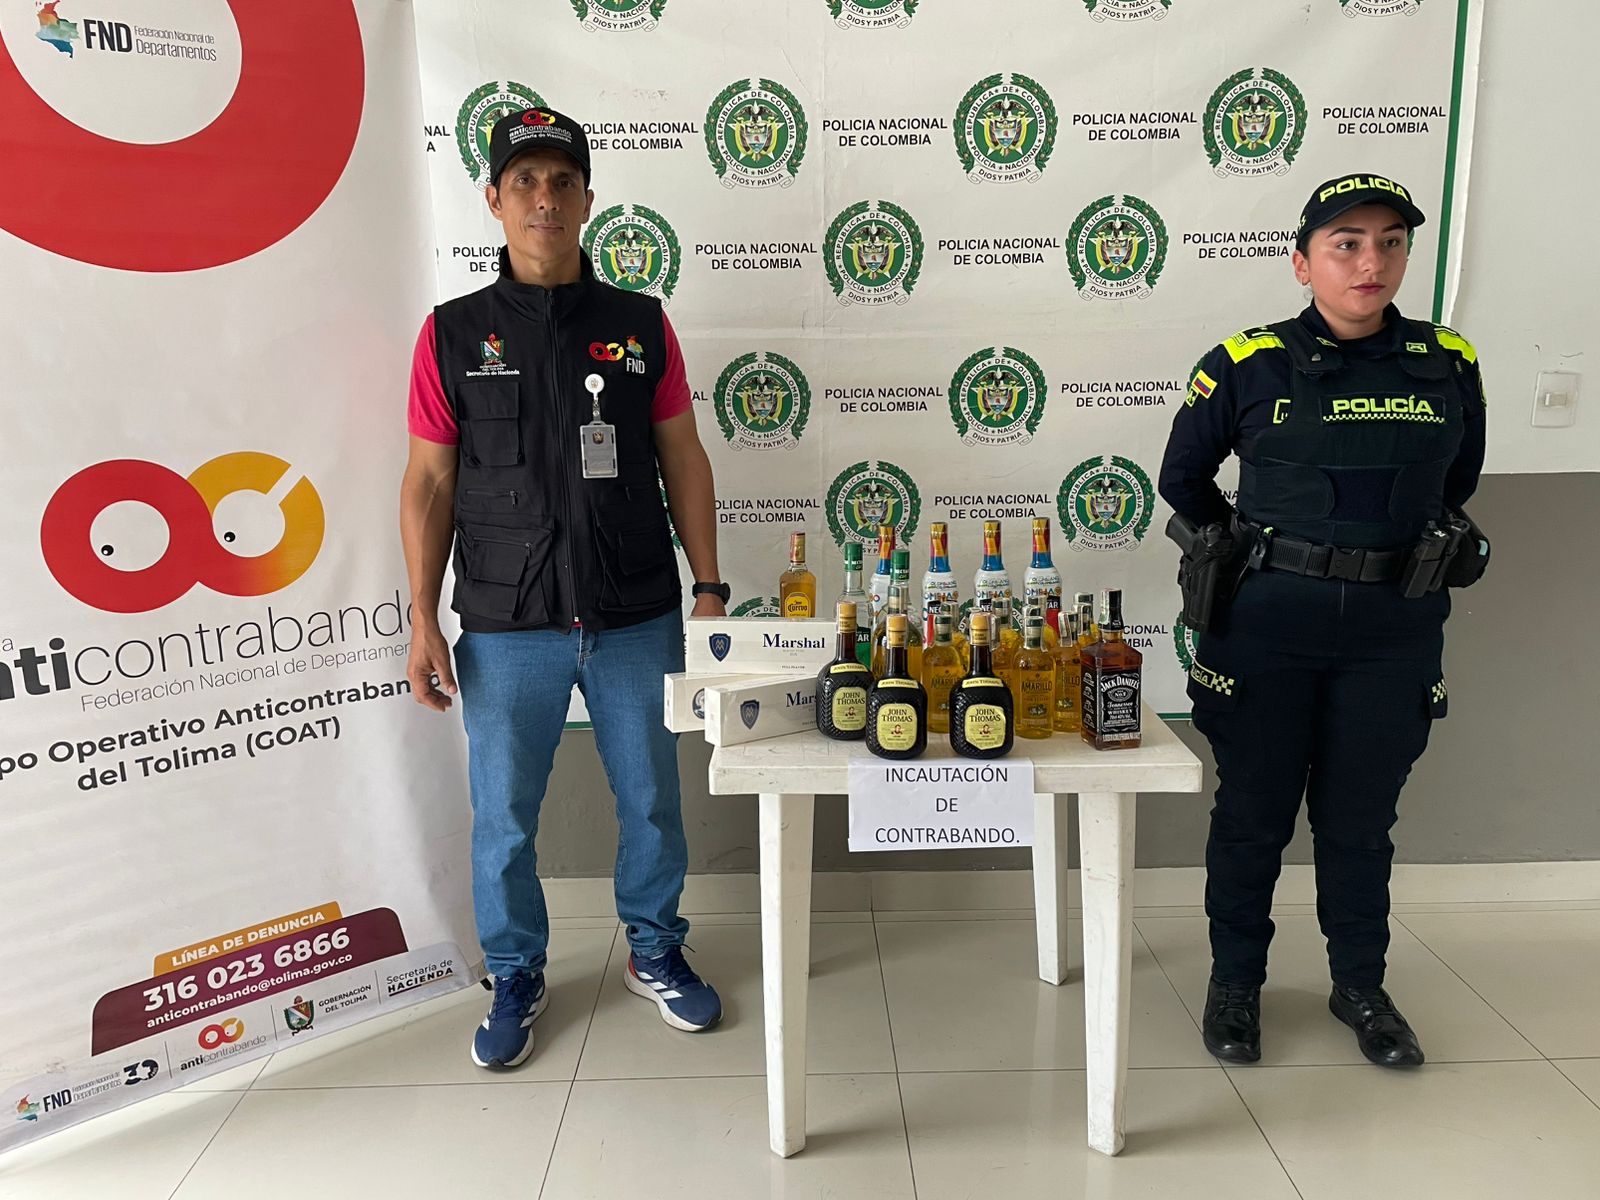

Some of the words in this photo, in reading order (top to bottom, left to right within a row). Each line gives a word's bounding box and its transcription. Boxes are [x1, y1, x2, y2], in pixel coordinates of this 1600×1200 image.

[592, 16, 612, 29] DIOS
[619, 16, 647, 30] PATRIA
[84, 19, 132, 53] FND
[134, 25, 173, 40] Federación
[174, 31, 204, 44] Nacional
[204, 35, 215, 44] de
[136, 39, 217, 62] Departamentos
[1215, 84, 1245, 130] REPUBLICA
[1270, 85, 1293, 129] COLOMBIA
[1323, 107, 1375, 119] POLICIA
[1378, 106, 1446, 118] NACIONAL
[718, 96, 743, 141] REPUBLICA
[770, 96, 795, 141] COLOMBIA
[822, 119, 876, 131] POLICIA
[879, 117, 948, 130] NACIONAL
[1072, 113, 1126, 125] POLICIA
[1130, 112, 1197, 124] NACIONAL
[582, 123, 625, 135] OLICIA
[629, 122, 698, 134] NACIONAL
[1088, 130, 1106, 141] DE
[1110, 128, 1180, 140] COLOMBIA
[1338, 123, 1355, 134] DE
[1359, 122, 1429, 134] COLOMBIA
[591, 139, 607, 150] DE
[611, 138, 683, 150] COLOMBIA
[839, 136, 856, 147] DE
[860, 134, 931, 146] COLOMBIA
[1218, 139, 1244, 164] POLICIA
[1252, 138, 1290, 164] NACIONAL
[723, 150, 748, 175] POLICIA
[757, 150, 793, 176] NACIONAL
[1225, 162, 1244, 174] DIOS
[1251, 161, 1280, 174] PATRIA
[731, 173, 750, 186] DIOS
[757, 172, 784, 187] PATRIA
[1320, 177, 1409, 203] POLICIA
[1183, 232, 1236, 244] POLICIA
[1239, 230, 1297, 243] NACIONA
[695, 244, 747, 255] POLICIA
[750, 242, 817, 254] NACIONAL
[938, 239, 990, 251] POLICIA
[993, 238, 1060, 250] NACIONAL
[453, 246, 500, 258] POLICIA
[953, 255, 970, 265] DE
[974, 253, 1044, 264] COLOMBIA
[1199, 248, 1217, 259] DE
[1220, 247, 1289, 258] COLOMBIA
[470, 262, 487, 272] DE
[711, 259, 728, 270] DE
[732, 258, 802, 270] COLOMBIA
[626, 357, 646, 374] FND
[726, 367, 750, 408] REPUBLICA
[775, 367, 799, 408] COLOMBIA
[825, 388, 874, 399] POLICIA
[878, 386, 943, 398] NACIONAL
[1061, 382, 1112, 394] POLICIA
[1115, 381, 1181, 393] NACIONAL
[840, 402, 857, 413] DE
[861, 401, 927, 412] COLOMBIA
[1076, 397, 1093, 407] DE
[1097, 395, 1166, 407] COLOMBIA
[1332, 394, 1434, 413] POLICÍA
[731, 415, 755, 438] POLICIA
[763, 414, 796, 439] NACIONAL
[739, 436, 757, 448] DIOS
[763, 436, 789, 448] PATRIA
[1069, 469, 1096, 510] REPUBLICA
[1120, 470, 1143, 510] COLOMBIA
[715, 500, 753, 510] OLICIA
[756, 498, 820, 509] NACIONAL
[934, 495, 984, 506] POLICIA
[987, 493, 1052, 505] NACIONAL
[720, 513, 736, 524] DE
[740, 512, 805, 523] COLOMBIA
[949, 509, 966, 519] DE
[970, 508, 1036, 518] COLOMBIA
[1073, 517, 1097, 540] POLICIA
[1105, 517, 1140, 540] NACIONAL
[1080, 538, 1098, 549] DIOS
[1104, 537, 1130, 549] PATRIA
[1123, 625, 1168, 635] CIONAL
[0, 590, 412, 700] ticontraband
[763, 633, 825, 649] Marshal
[81, 679, 195, 712] Federación
[200, 660, 280, 690] Nacional
[284, 655, 307, 674] de
[1101, 679, 1116, 692] JACK
[888, 708, 907, 716] JOHN
[969, 714, 1001, 722] THOMAS
[976, 708, 995, 716] JOHN
[48, 718, 205, 767] Operativo
[214, 673, 440, 729] Anticontrabano
[78, 760, 127, 790] del
[136, 739, 236, 777] Tolima
[246, 716, 340, 757] (GOAT)
[885, 764, 1008, 782] INCAUTACIÓN
[936, 797, 958, 812] DE
[875, 827, 1020, 843] CONTRABANDO.
[172, 943, 219, 966] LÍNEA
[223, 935, 244, 951] DE
[248, 911, 325, 943] DENUNCIA
[143, 975, 198, 1012] 316
[207, 953, 265, 989] 023
[274, 927, 350, 967] 6866
[386, 963, 437, 984] Secretaría
[440, 959, 453, 968] de
[388, 967, 453, 993] HACIENDA
[147, 954, 353, 1028] anticontrabando@tolima.gov.co
[318, 984, 372, 1007] GOBERNACIÓN
[325, 1005, 339, 1013] DEL
[340, 994, 368, 1009] TOLIMA
[180, 1034, 267, 1071] anticontrabando
[73, 1079, 122, 1102] Departamentos
[43, 1089, 72, 1112] FND
